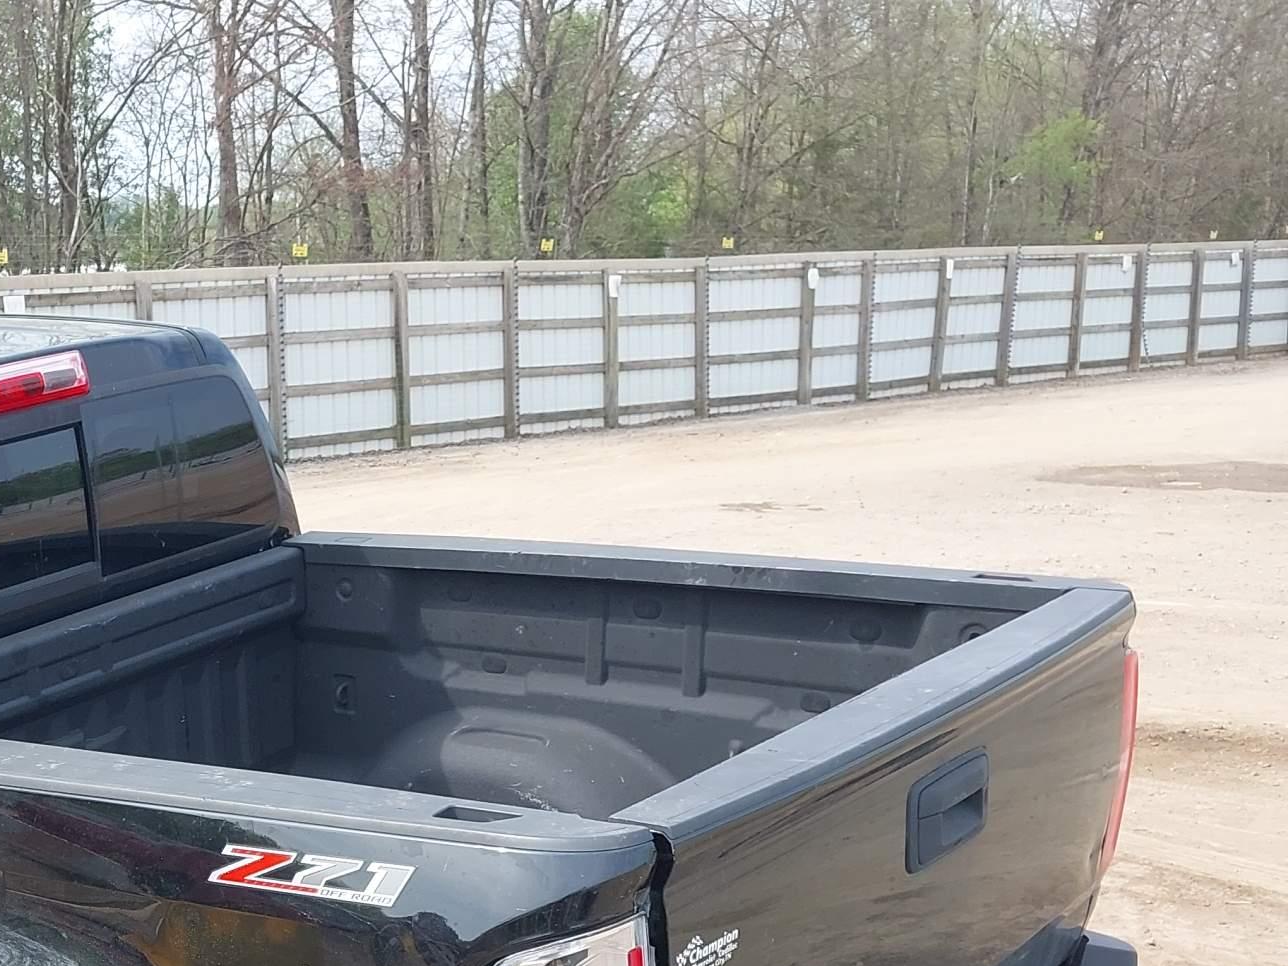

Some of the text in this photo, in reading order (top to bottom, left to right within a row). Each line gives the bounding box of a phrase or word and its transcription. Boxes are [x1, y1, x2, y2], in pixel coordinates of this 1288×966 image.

[208, 843, 416, 897] Z71
[320, 889, 347, 898] OFF
[690, 929, 739, 963] Champion
